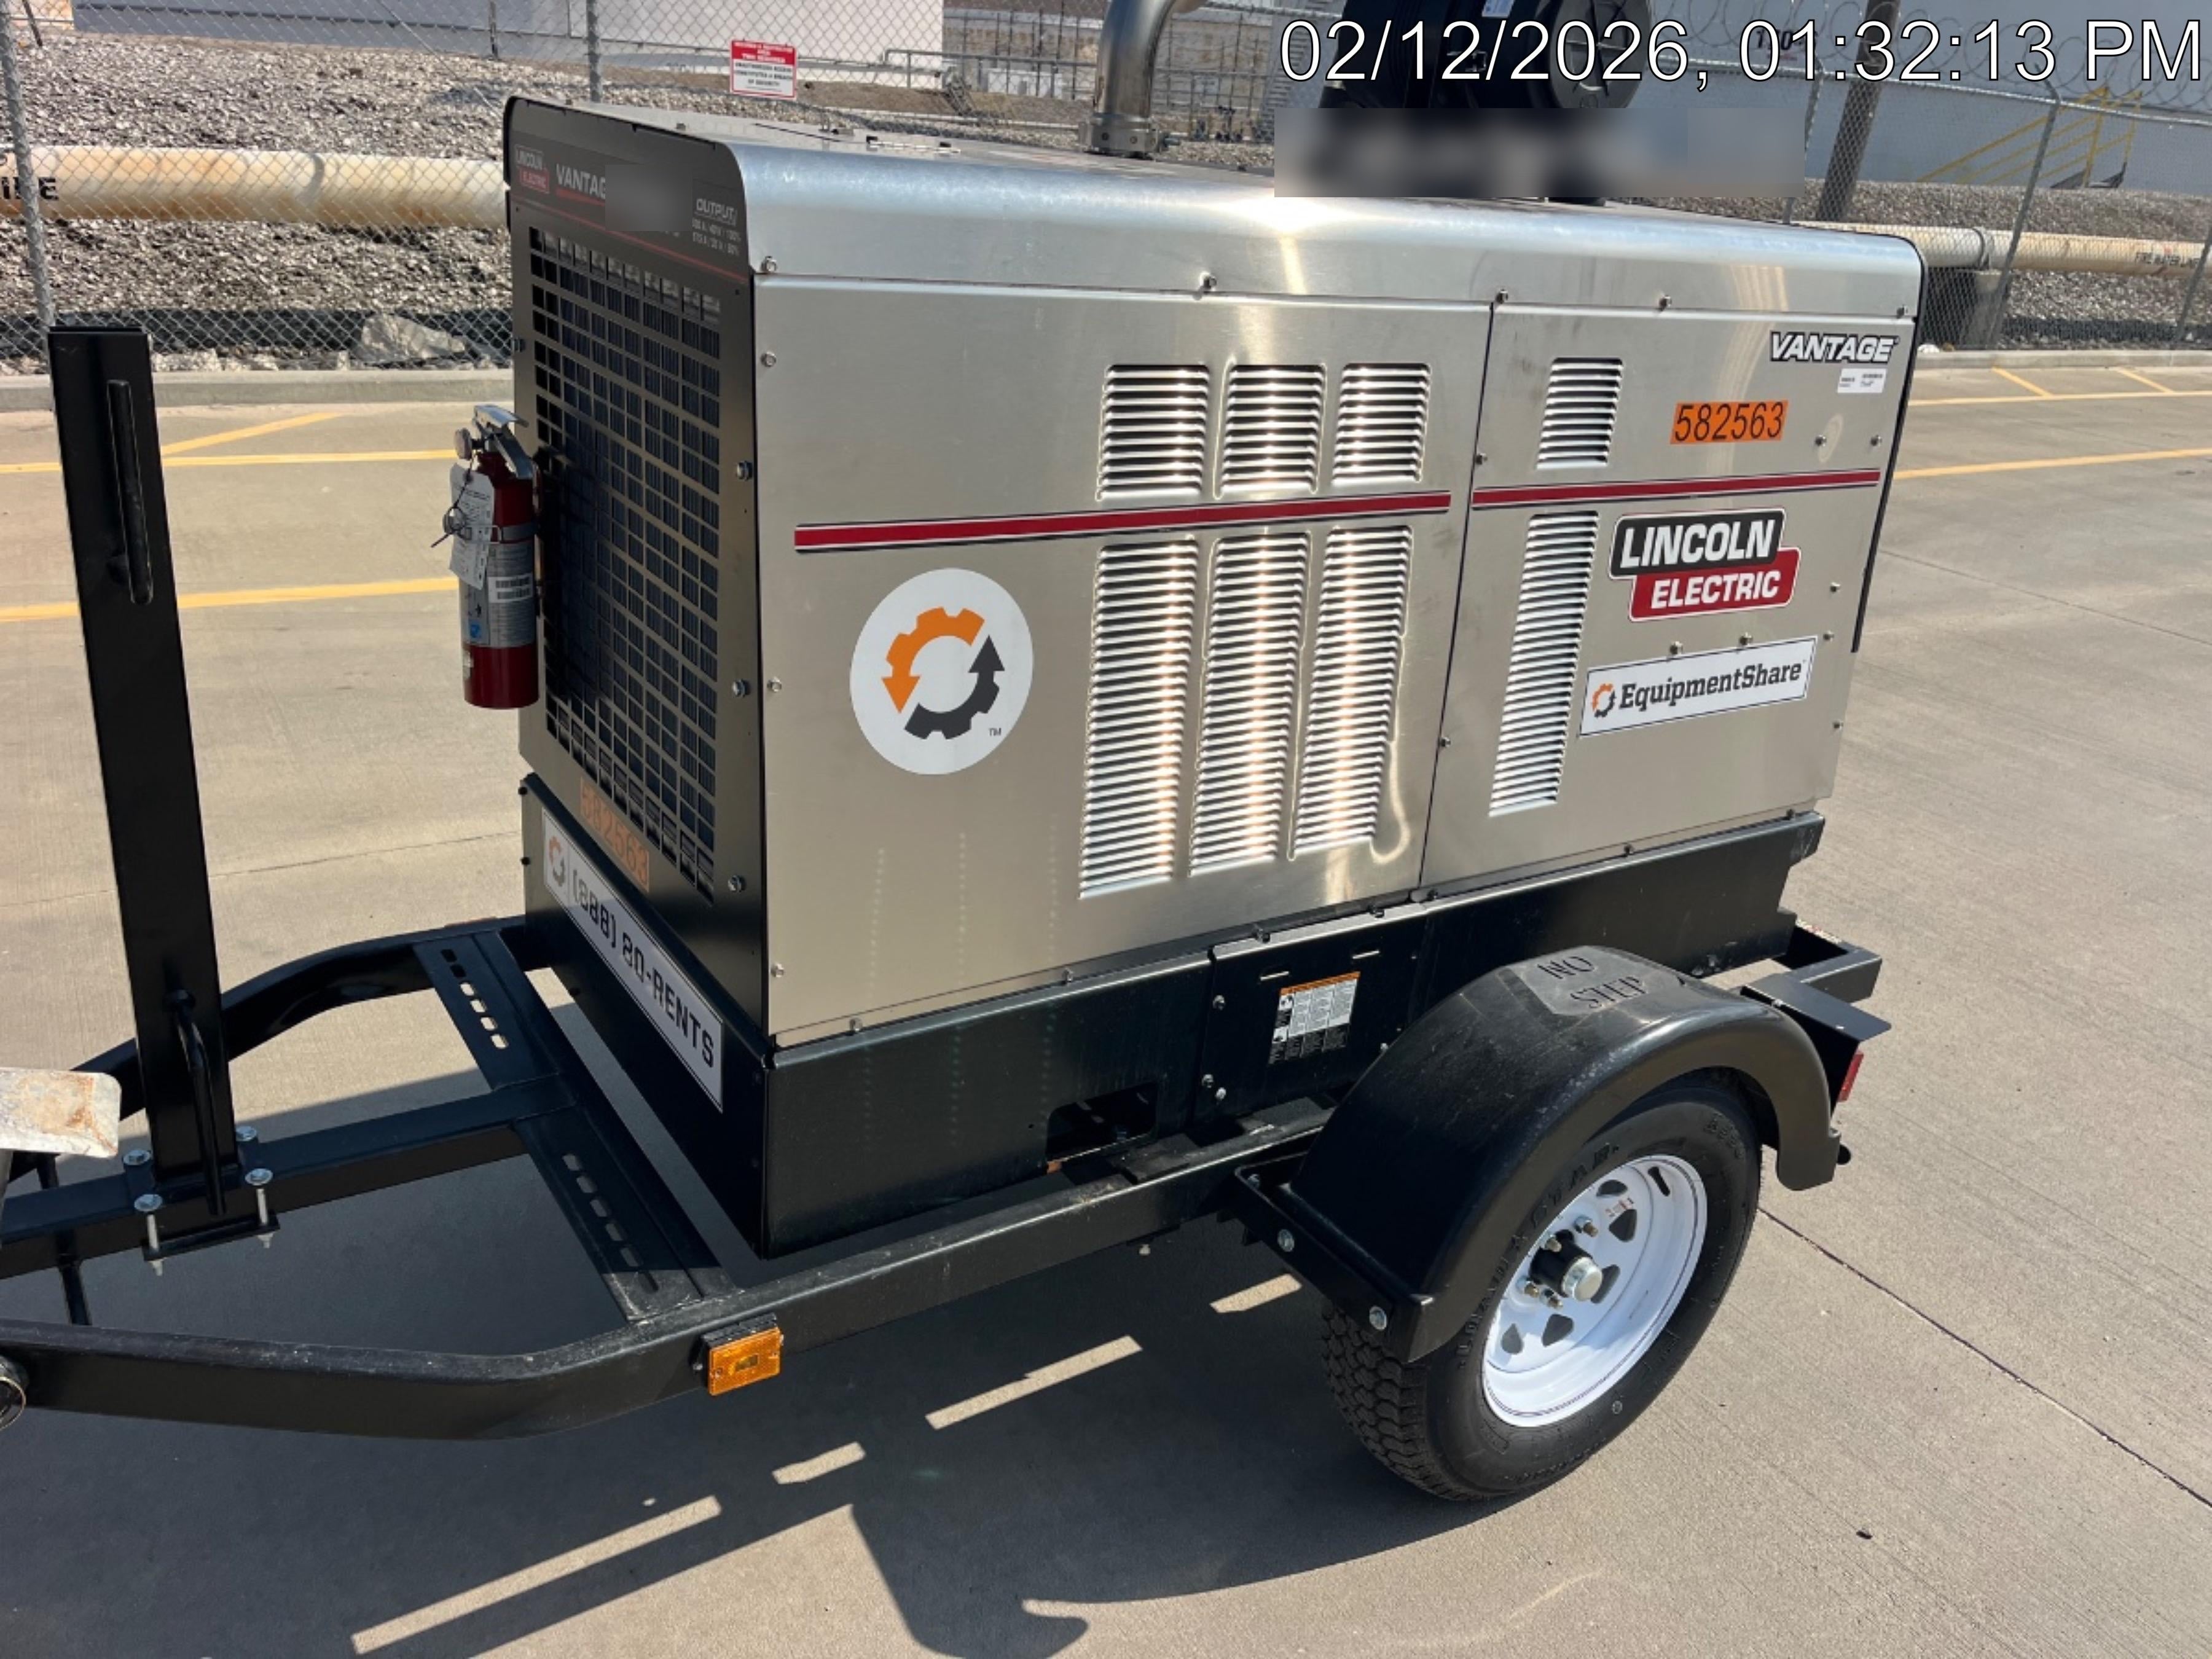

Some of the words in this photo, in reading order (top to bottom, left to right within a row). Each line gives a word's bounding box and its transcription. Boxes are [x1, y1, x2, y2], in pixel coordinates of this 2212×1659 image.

[555, 162, 606, 200] VANTAG
[1771, 331, 1897, 364] VANTAGE
[1674, 401, 1784, 442] 582563
[1620, 519, 1776, 570] LINCOLN
[1650, 570, 1781, 610] ELECTRIC
[1618, 661, 1802, 710] EquipmentShare
[573, 869, 617, 949] (888)
[622, 931, 714, 1069] 80-RENTS
[1537, 955, 1596, 980] NO
[1570, 976, 1649, 1010] STEP
